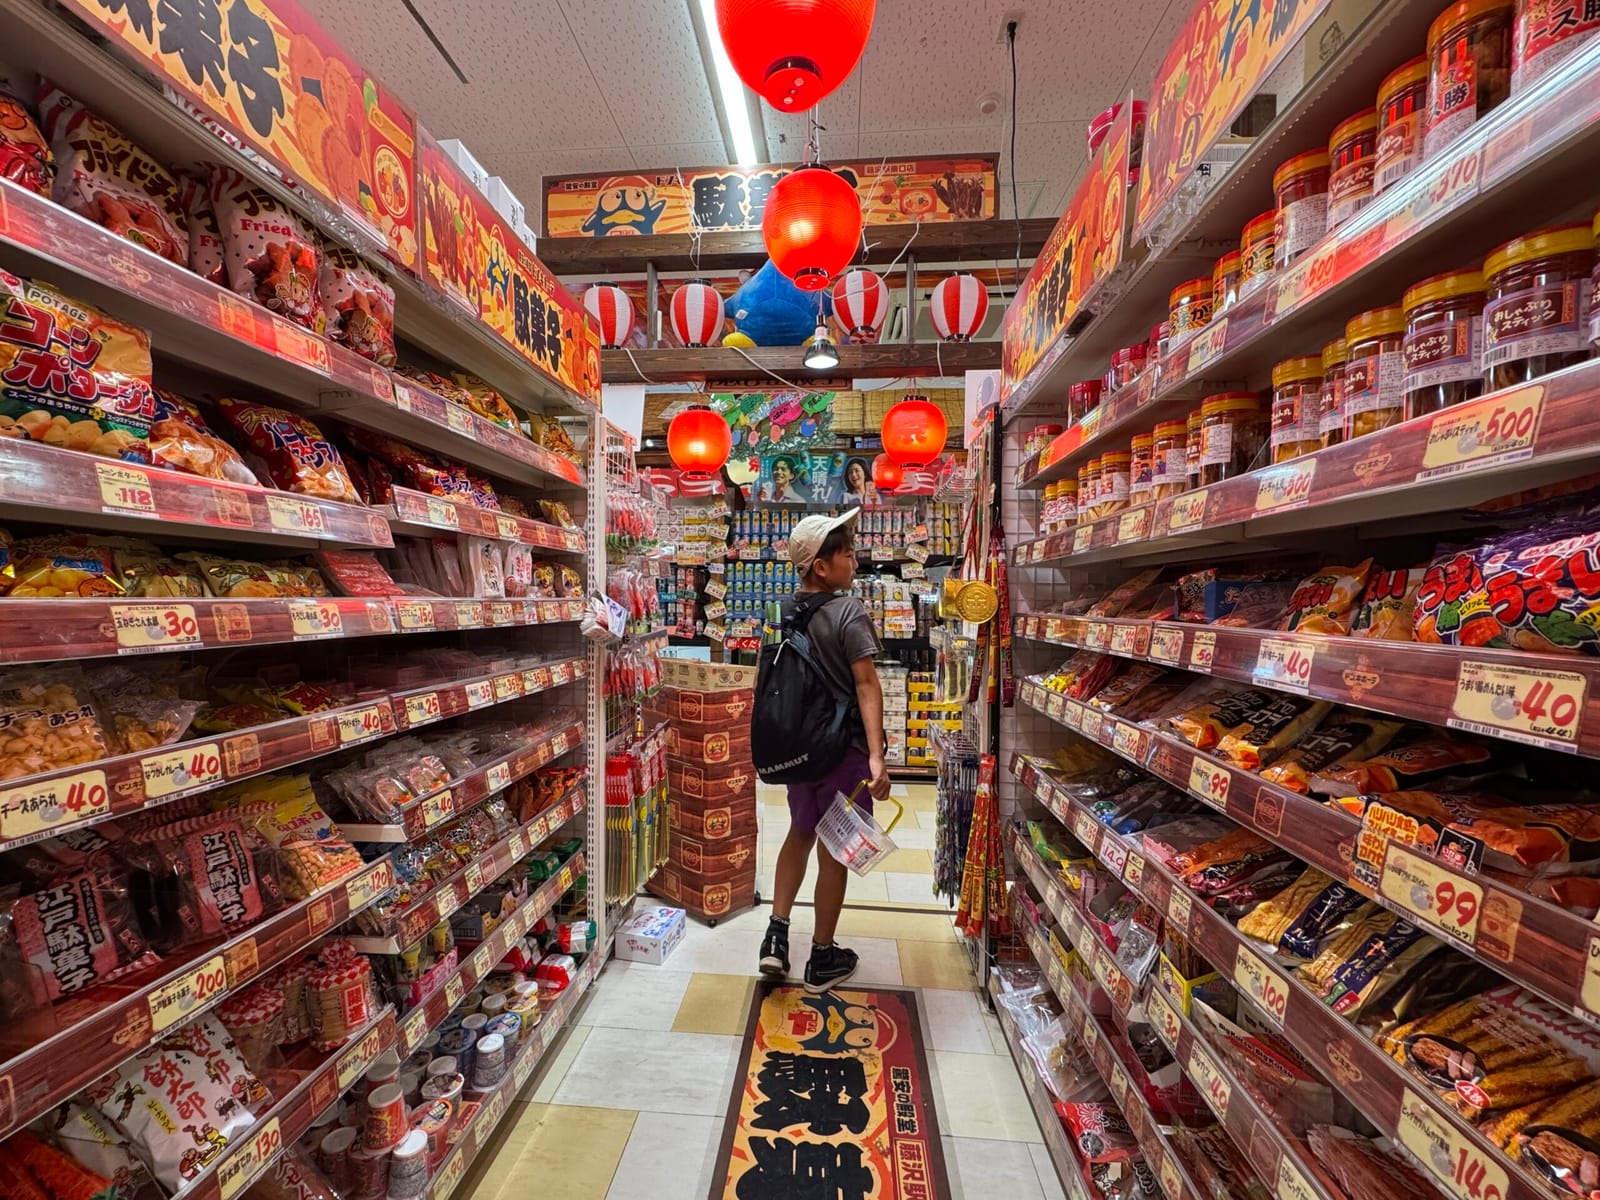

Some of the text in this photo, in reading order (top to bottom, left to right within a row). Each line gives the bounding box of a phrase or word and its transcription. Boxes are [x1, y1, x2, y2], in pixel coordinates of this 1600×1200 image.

[241, 219, 292, 238] Fried
[30, 290, 88, 322] POTAGE
[1494, 300, 1553, 321] おしゃぶり
[0, 299, 102, 365] コーン
[513, 273, 562, 373] 駄菓子
[1502, 311, 1556, 331] スティック
[3, 351, 156, 418] ポタージュ
[1486, 406, 1534, 442] 500
[119, 487, 152, 506] 118
[300, 506, 321, 528] 165
[164, 610, 197, 638] 30
[320, 607, 341, 628] 30
[1286, 651, 1311, 680] 40
[425, 697, 438, 715] 25
[480, 684, 492, 699] 35
[1522, 679, 1577, 727] 40
[49, 704, 95, 727] あられ
[363, 711, 380, 730] 40
[190, 753, 219, 779] 40
[758, 753, 810, 776] MAMMUT
[1, 781, 106, 819] チーズあられ 40
[1211, 772, 1228, 799] 99
[1103, 847, 1125, 870] 149
[202, 831, 247, 924] 江戸駄菓子
[371, 870, 387, 892] 120
[1435, 880, 1478, 928] 99
[36, 882, 97, 995] 江戸駄菓子
[196, 968, 225, 1001] 200
[1262, 975, 1285, 1015] 100
[143, 1055, 207, 1120] 餅太郎
[891, 1066, 919, 1134] 驚安の殿堂
[1210, 1076, 1228, 1109] 40
[255, 1129, 280, 1163] 130
